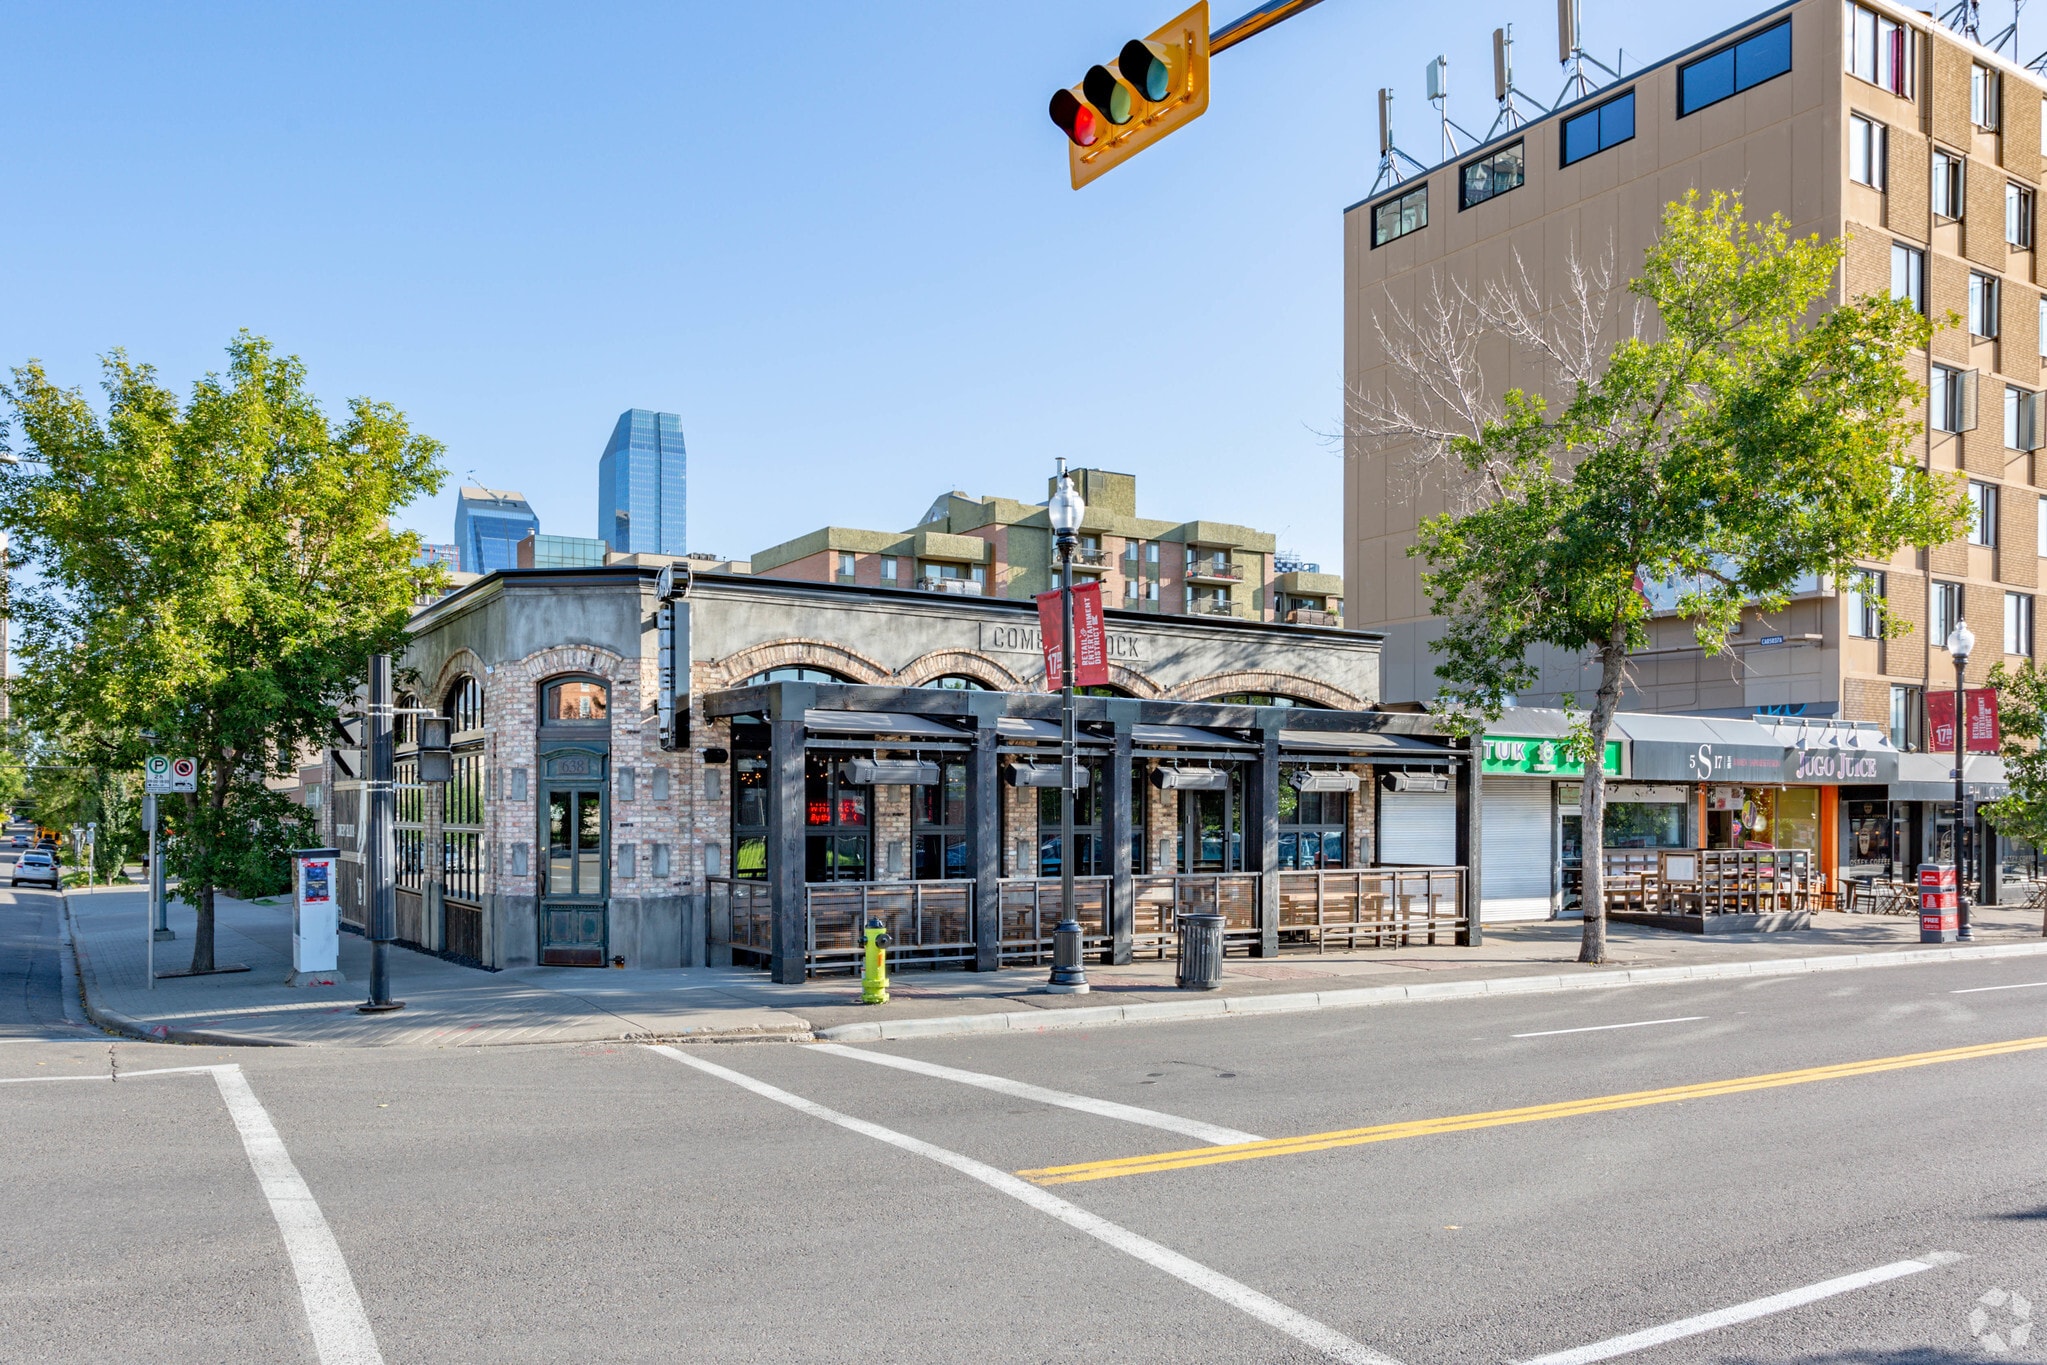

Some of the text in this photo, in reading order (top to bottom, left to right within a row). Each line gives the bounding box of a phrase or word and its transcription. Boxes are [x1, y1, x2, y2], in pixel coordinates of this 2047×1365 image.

[1084, 597, 1095, 666] ENTERTAINMENT
[1081, 638, 1089, 666] RETAIL
[1092, 627, 1102, 665] DISTRICT
[1047, 653, 1057, 675] 17
[1483, 740, 1526, 761] TUK
[562, 760, 584, 773] 638
[1796, 751, 1877, 779] JUGO JUICE
